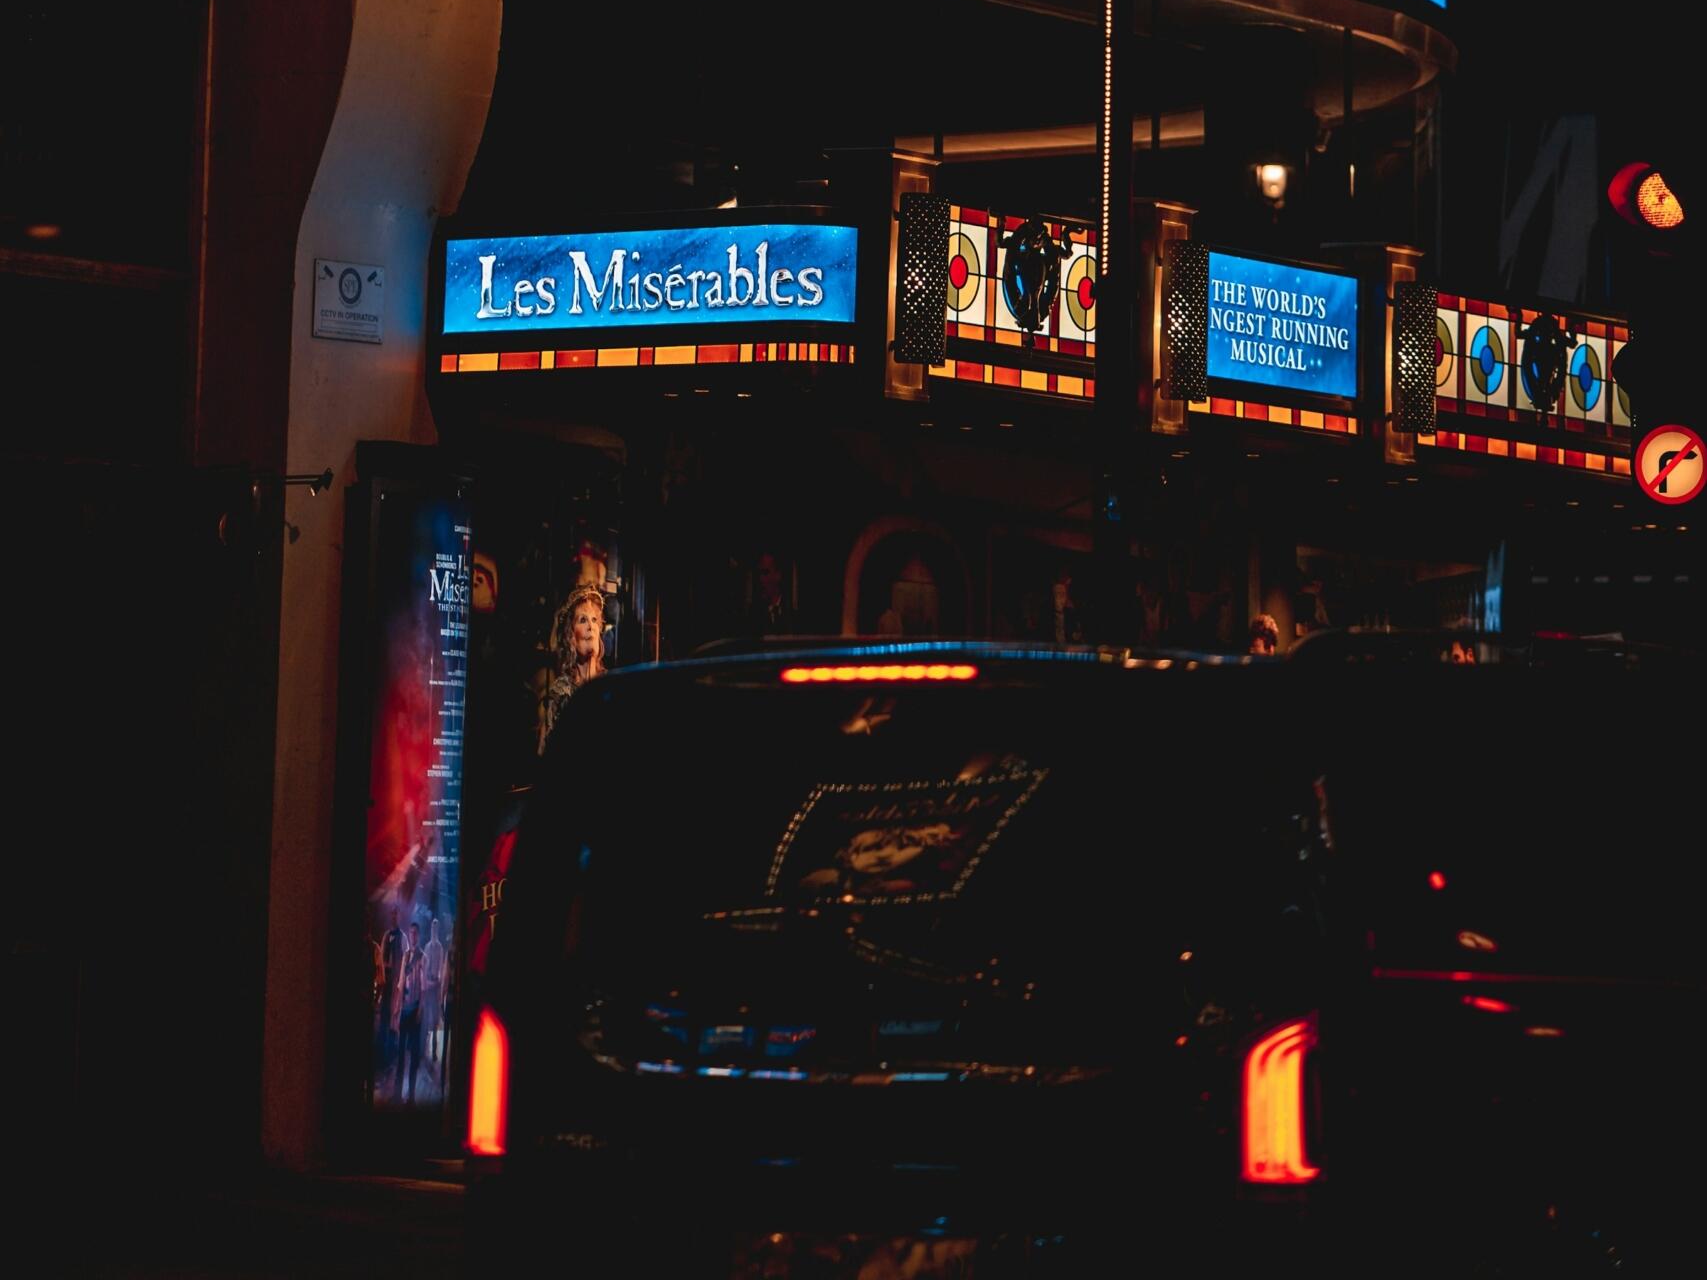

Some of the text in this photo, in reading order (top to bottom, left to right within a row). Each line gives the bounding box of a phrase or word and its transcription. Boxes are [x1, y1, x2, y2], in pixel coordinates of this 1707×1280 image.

[476, 240, 824, 320] Les Misérables
[1211, 279, 1248, 306] THE
[320, 308, 337, 319] CCTV
[345, 311, 379, 323] OPERATION
[1271, 317, 1350, 351] RUNNING
[1230, 338, 1307, 372] MUSICAL
